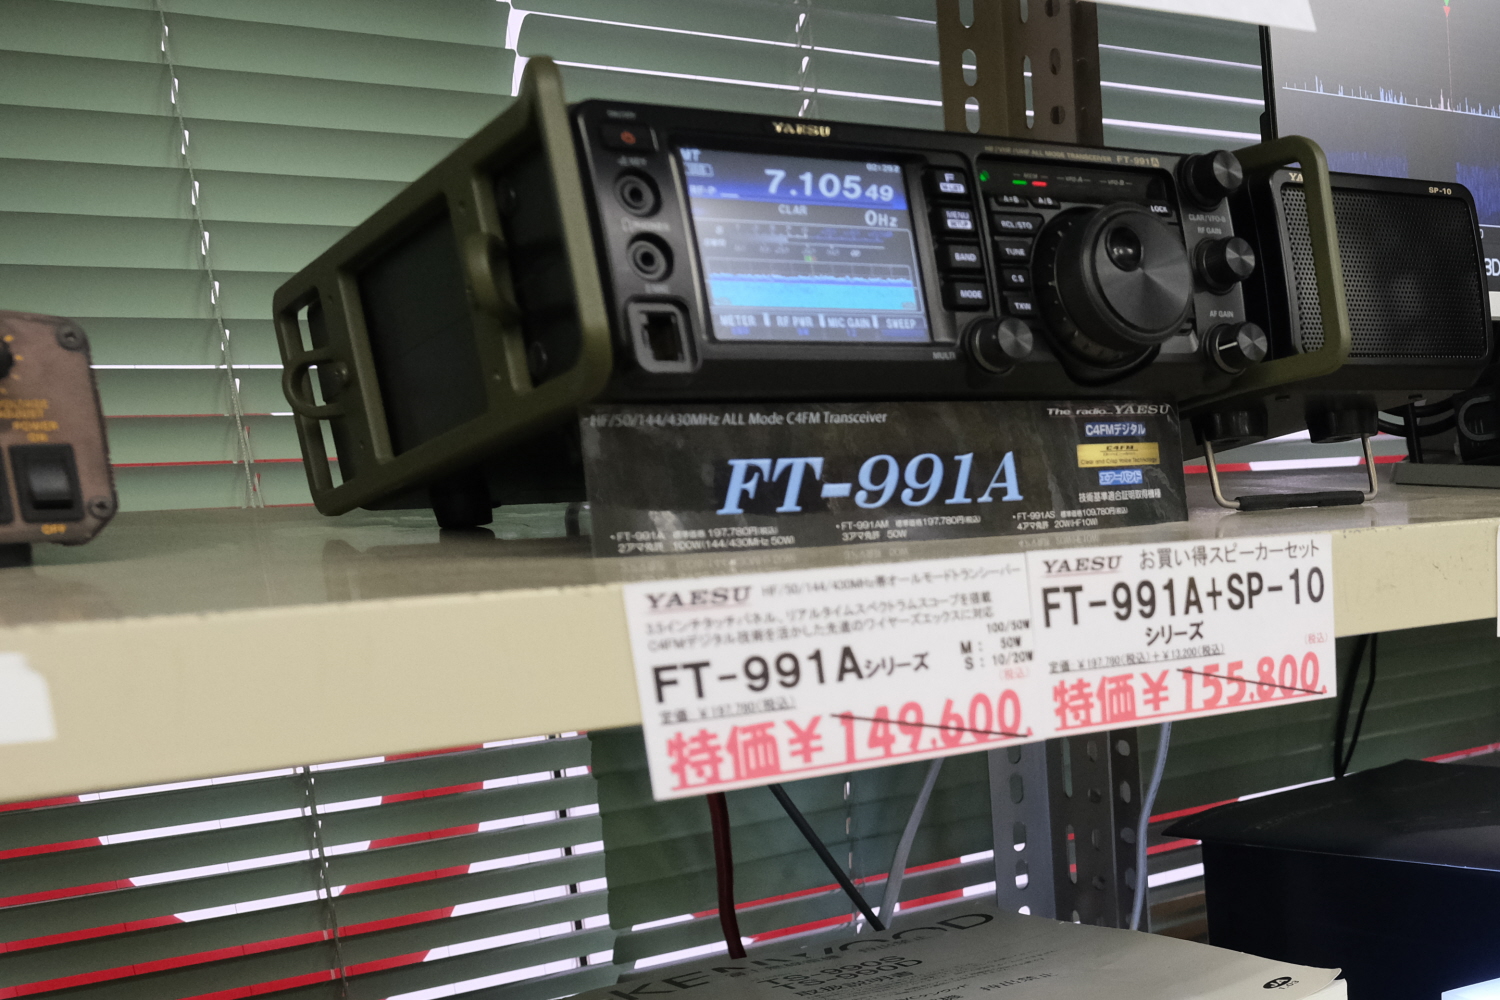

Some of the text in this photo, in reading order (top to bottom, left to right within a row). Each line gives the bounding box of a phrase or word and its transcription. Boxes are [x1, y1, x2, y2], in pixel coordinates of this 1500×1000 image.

[772, 122, 831, 137] YAESU
[1428, 186, 1452, 195] SP-10
[778, 205, 808, 215] CLAR
[1150, 204, 1168, 214] LOCK
[864, 210, 898, 228] 0Hz
[946, 210, 969, 221] MENU
[954, 252, 977, 263] BAND
[1005, 246, 1026, 257] TUNE
[960, 289, 983, 299] MODE
[720, 314, 757, 326] METER
[1219, 310, 1234, 319] GAIN
[847, 317, 871, 329] GAIN
[886, 319, 916, 329] SWEEP
[932, 351, 956, 360] MULTI
[1047, 404, 1170, 416] The YAESU
[721, 412, 746, 426] ALL
[749, 412, 784, 426] Mode
[786, 411, 821, 425] C4FM
[823, 410, 887, 424] Transceiver
[1085, 424, 1146, 437] C4FMデジタル
[716, 450, 1024, 516] FT-991A
[1079, 488, 1162, 503] 技術基準適合証明取得機種
[1017, 511, 1055, 521] FT-991AS
[841, 520, 889, 531] FT-991AM
[887, 529, 907, 540] 50W
[1042, 539, 1320, 574] YAESU お買い得スピーカーセット
[645, 585, 753, 609] YAESU
[1042, 566, 1325, 628] FT-991A+SP-10
[987, 618, 1031, 634] 100/50W
[1145, 621, 1205, 647] シリーズ
[1304, 632, 1328, 644] (税込)
[999, 636, 1022, 649] 50W
[992, 649, 1033, 667] 10/20W
[756, 954, 906, 985] TS-990S
[771, 958, 923, 991] TS-990D
